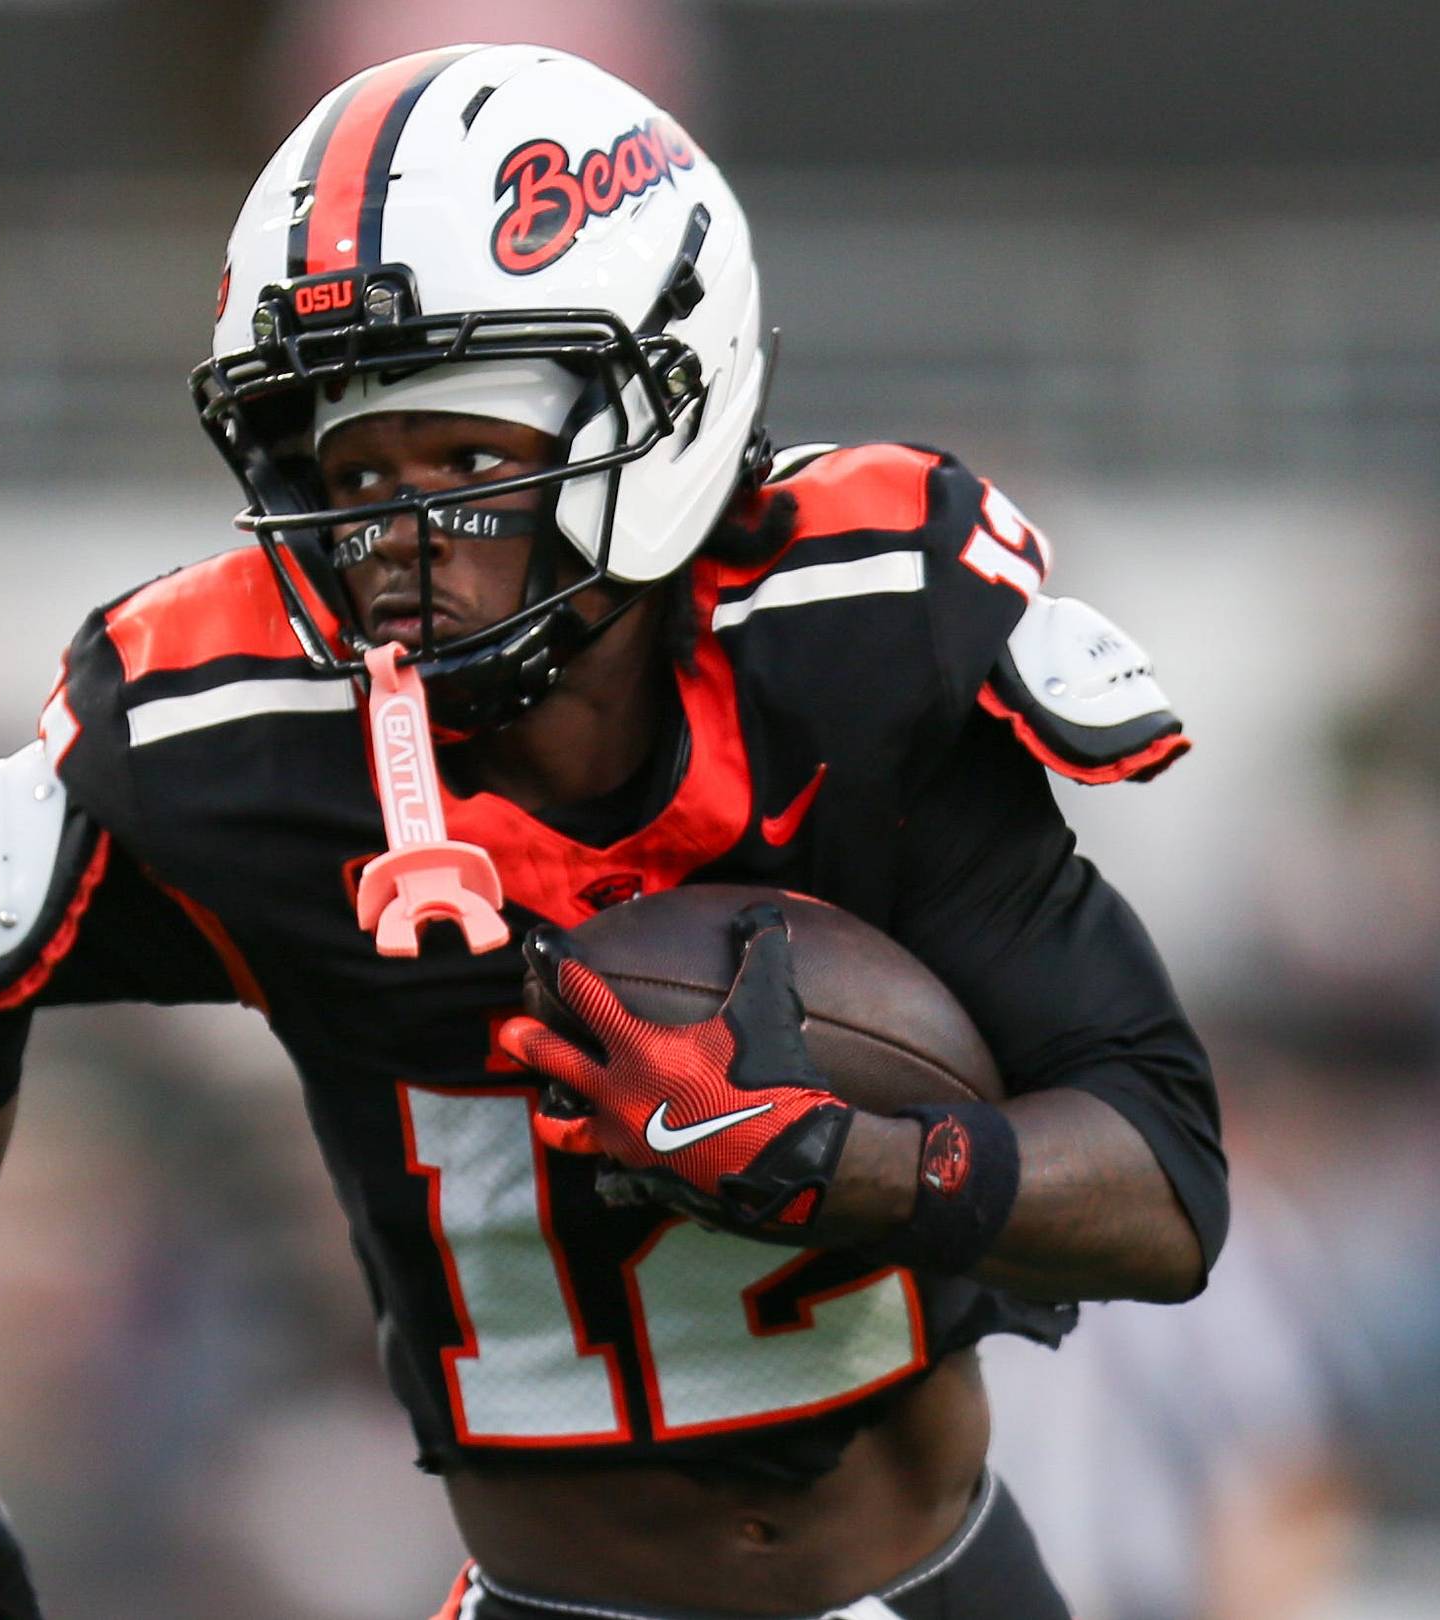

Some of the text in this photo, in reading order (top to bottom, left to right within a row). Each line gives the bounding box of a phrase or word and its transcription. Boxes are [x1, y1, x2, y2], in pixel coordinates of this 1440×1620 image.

[295, 280, 353, 316] OSU
[384, 714, 432, 843] BATTLE
[395, 1080, 928, 1448] 12
